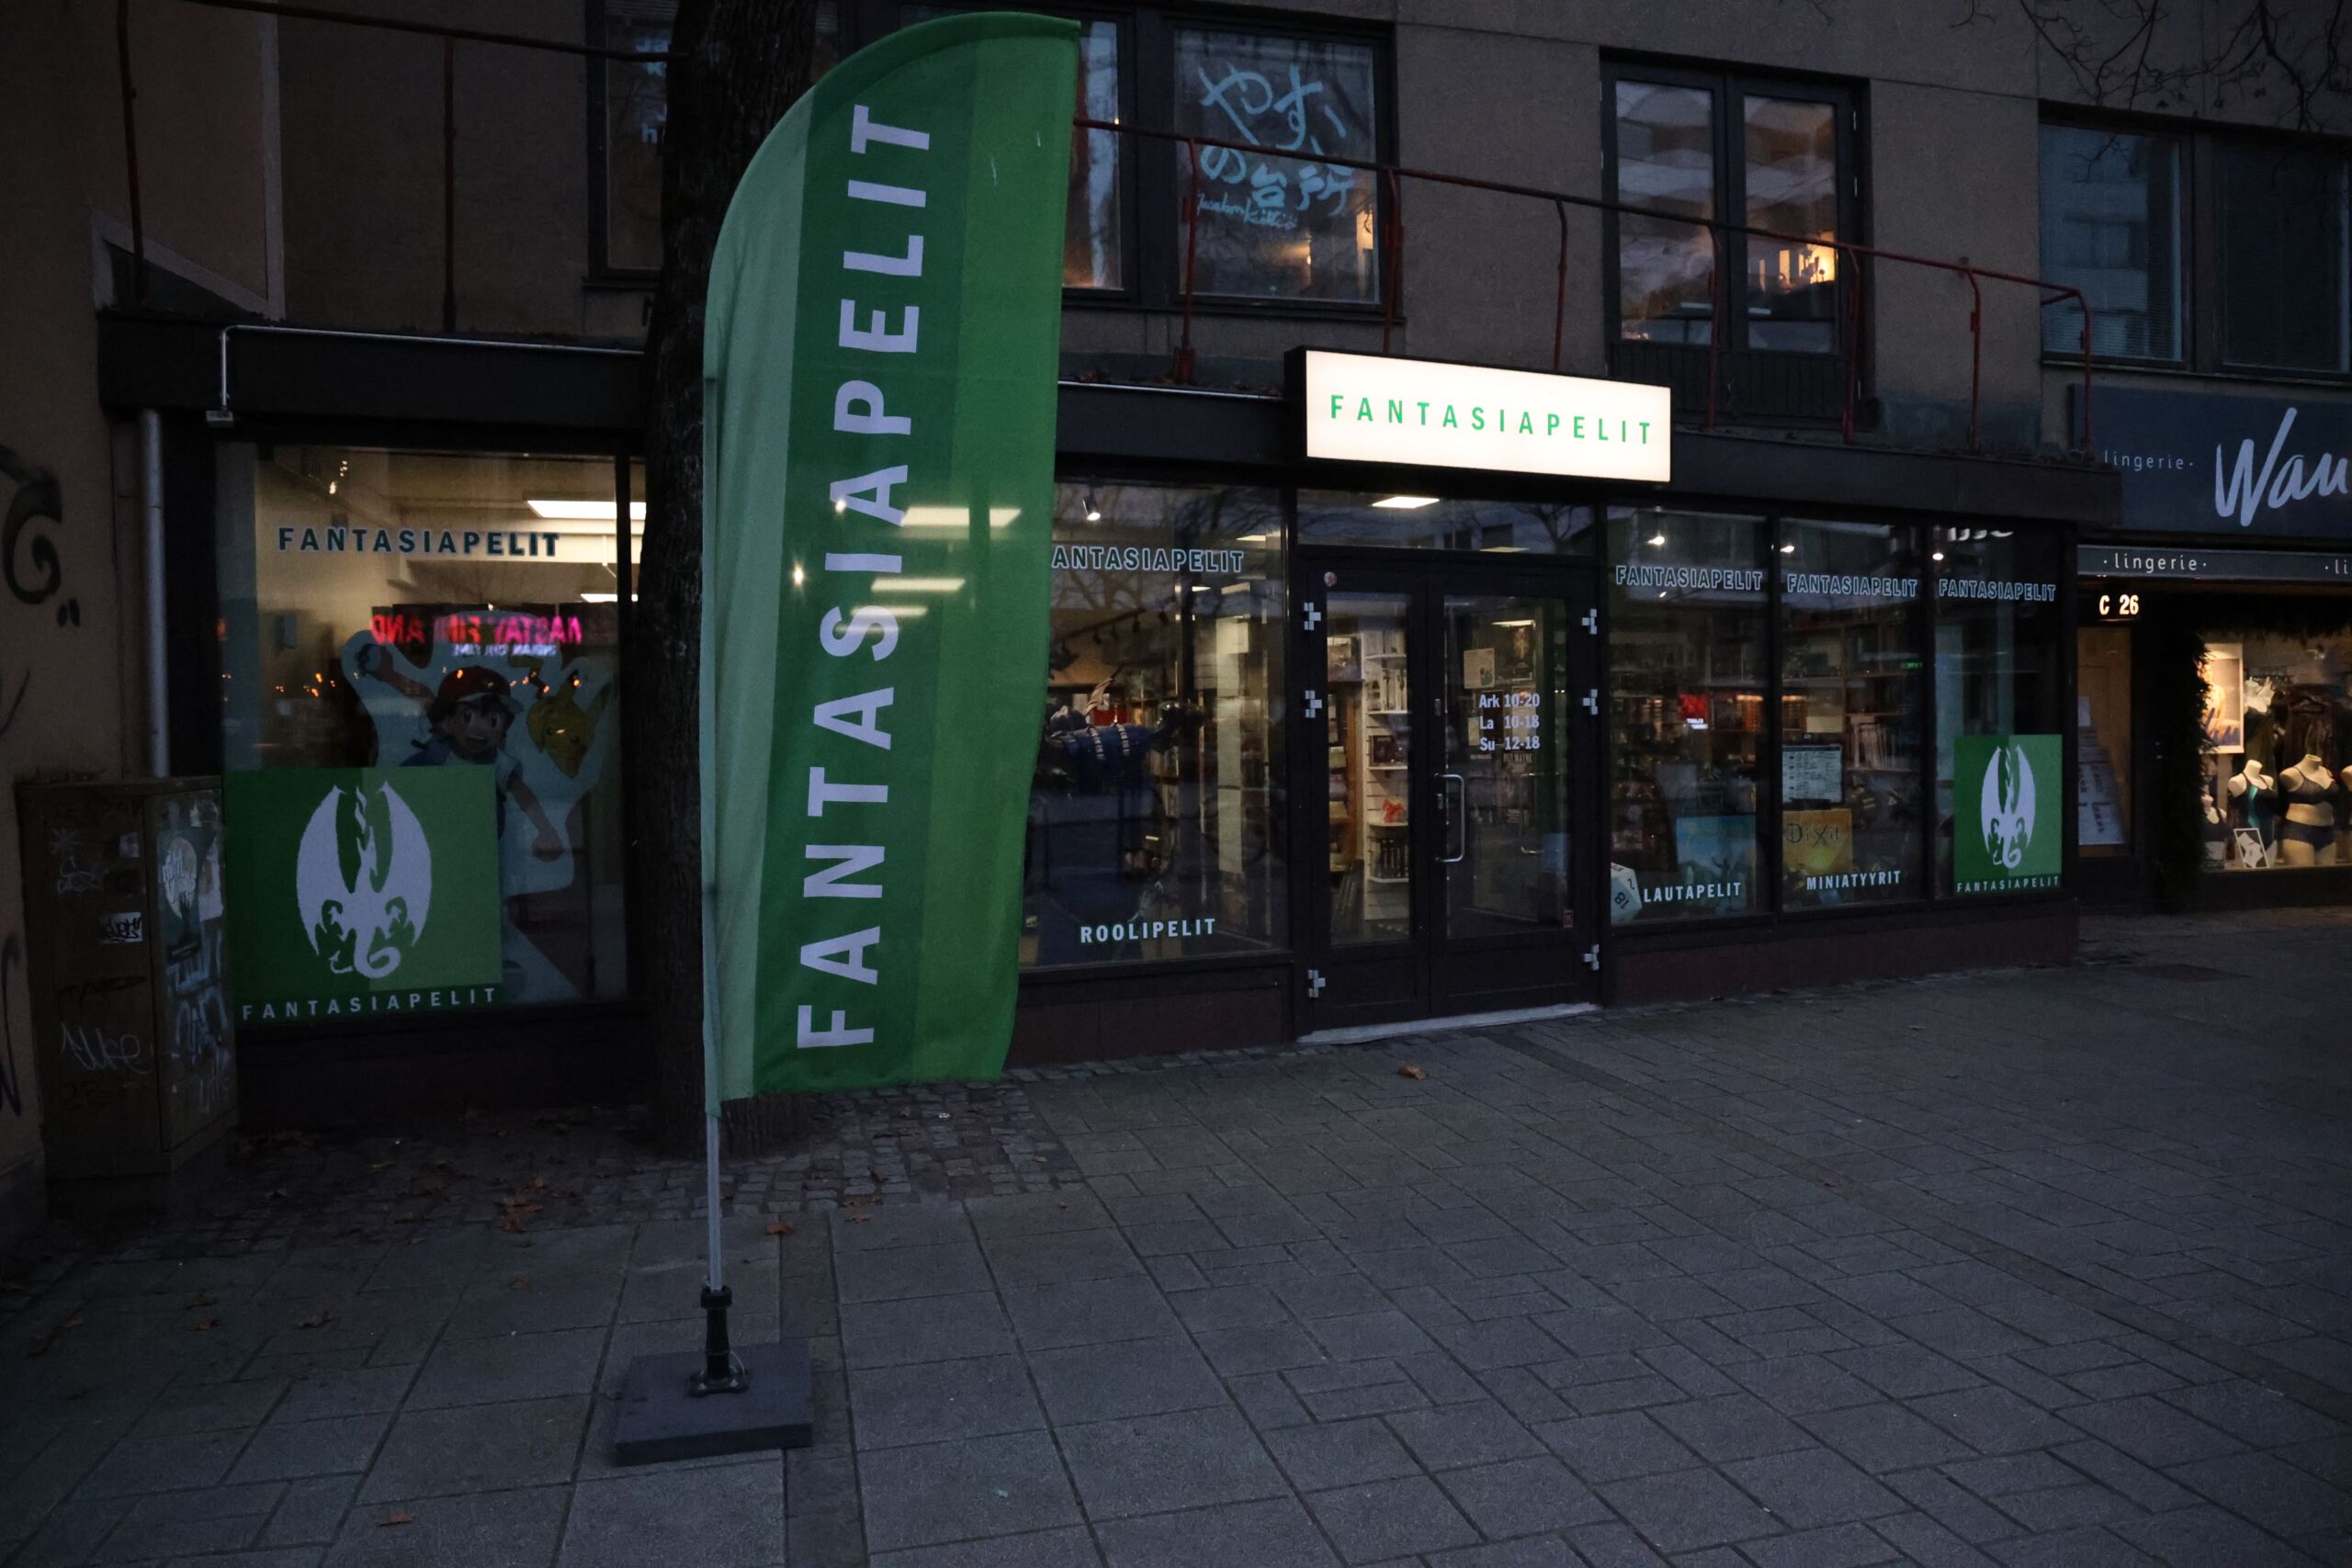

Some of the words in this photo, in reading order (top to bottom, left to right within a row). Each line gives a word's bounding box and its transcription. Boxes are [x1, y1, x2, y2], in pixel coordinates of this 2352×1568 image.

[1330, 394, 1651, 445] FANTASIAPELIT
[278, 527, 560, 558] FANTASIAPELIT
[1051, 545, 1244, 572] ANTASIAPELIT
[797, 105, 930, 1048] FANTASIAPELIT
[1615, 564, 1763, 591] FANTASIAPELIT
[1787, 573, 1918, 597] FANTASIAPELIT
[1939, 578, 2057, 603] FANTASIAPELIT
[2098, 594, 2110, 616] C
[2119, 594, 2140, 615] 26
[1478, 694, 1500, 709] Ark
[1504, 693, 1541, 707] 10-20
[1479, 716, 1494, 730] La
[1504, 715, 1541, 729] 10-18
[1479, 738, 1496, 751] Su
[1504, 736, 1541, 750] 12-18
[1643, 882, 1742, 903] LAUTAPELIT
[1806, 870, 1901, 891] MINIATYYRIT
[1957, 875, 2059, 894] FANTASIAPELIT
[1080, 919, 1216, 944] ROOLIPELIT
[243, 987, 497, 1022] FANTASIAPELIT
